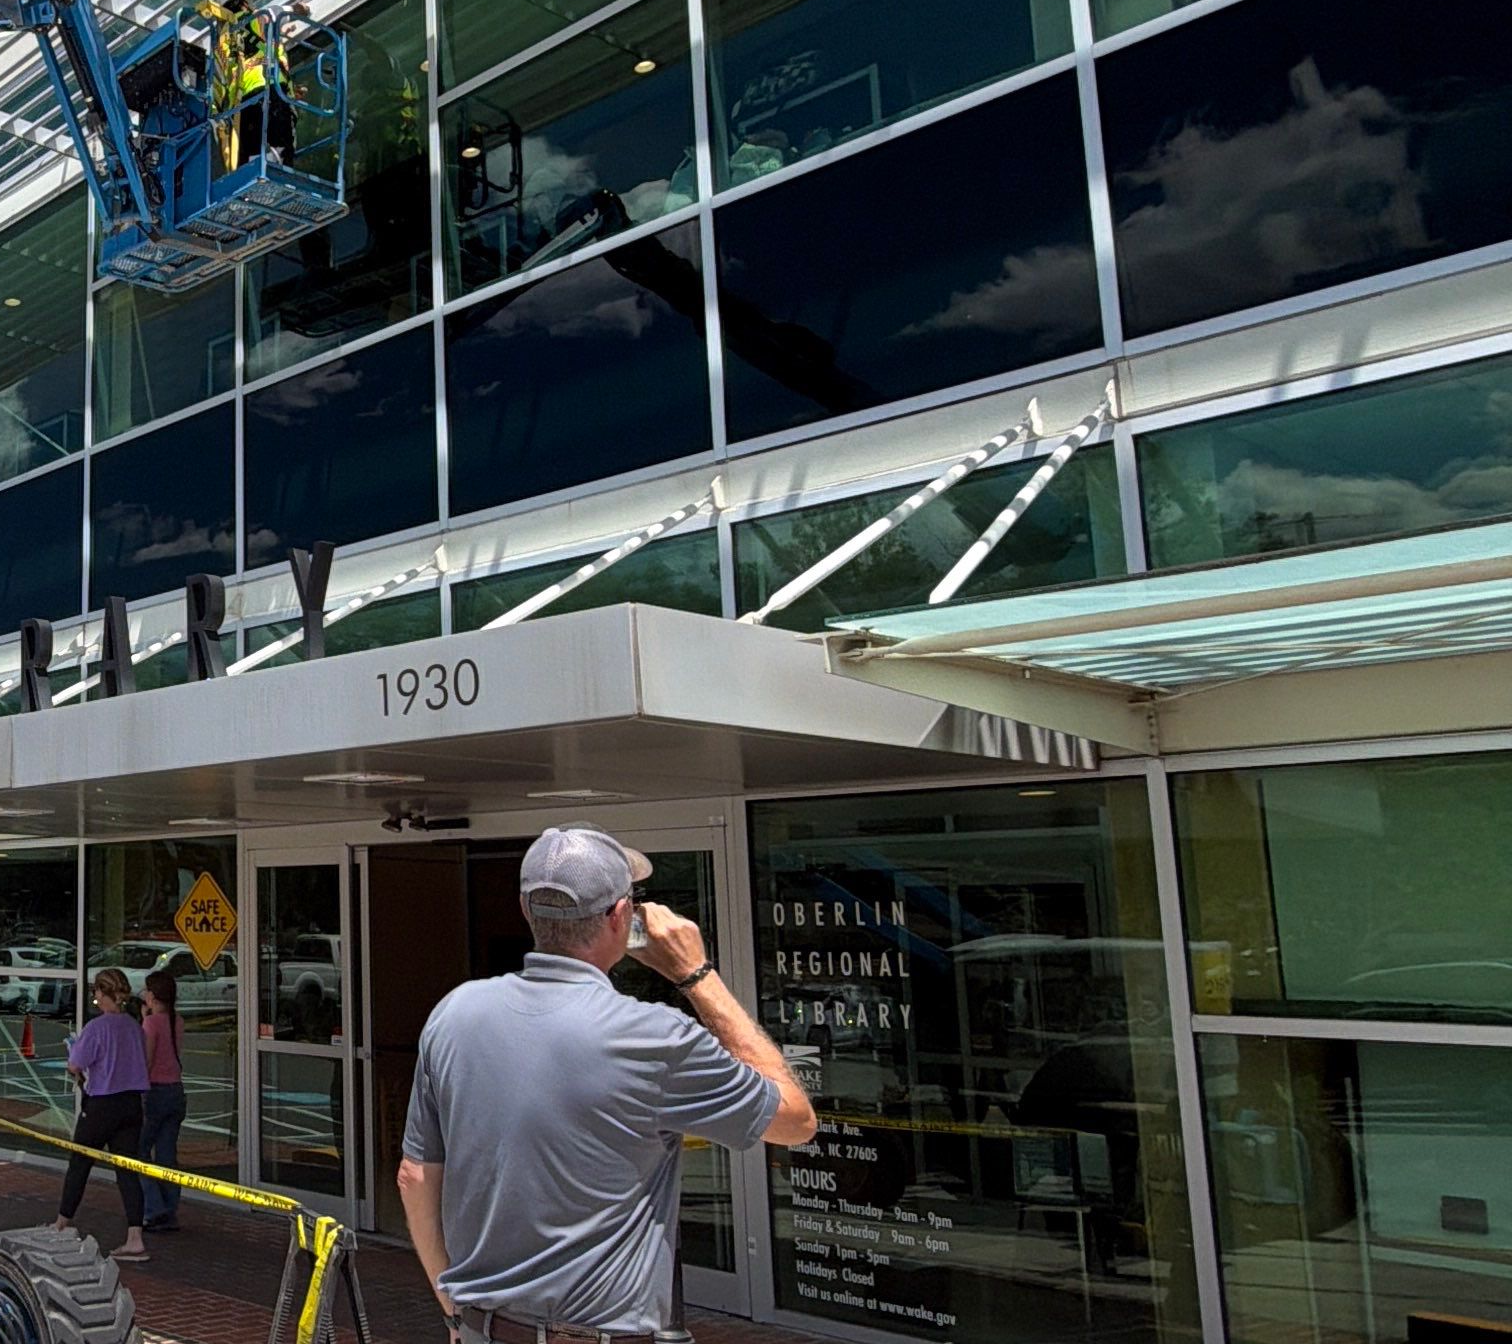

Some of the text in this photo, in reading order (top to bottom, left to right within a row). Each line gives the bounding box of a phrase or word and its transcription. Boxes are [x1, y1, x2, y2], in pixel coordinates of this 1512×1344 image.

[376, 658, 480, 717] 1930
[190, 899, 220, 915] SAFE
[773, 901, 906, 927] OBERLIN
[184, 916, 228, 933] PLACE
[776, 951, 911, 978] REGIONAL
[779, 999, 912, 1030] LIBRARY
[816, 1119, 838, 1134] lark
[843, 1122, 863, 1137] Ave.
[828, 1143, 841, 1157] NC
[846, 1145, 878, 1162] 27605
[162, 1169, 218, 1193] WET PAINT
[790, 1167, 837, 1192] HOURS
[792, 1192, 829, 1212] Monday
[838, 1198, 883, 1220] Thursday
[894, 1207, 918, 1224] 9am
[928, 1212, 952, 1229] 9pm
[793, 1214, 823, 1233] Friday
[825, 1219, 836, 1233] &
[837, 1221, 880, 1243] Saturday
[891, 1229, 915, 1246] 9am
[925, 1237, 950, 1253] 6pm
[794, 1237, 830, 1258] Sunday
[836, 1243, 857, 1260] 1pm
[866, 1248, 890, 1266] 5pm
[796, 1260, 874, 1286] Holidays Closed
[797, 1282, 956, 1326] Visit us online at www.wake.gov
